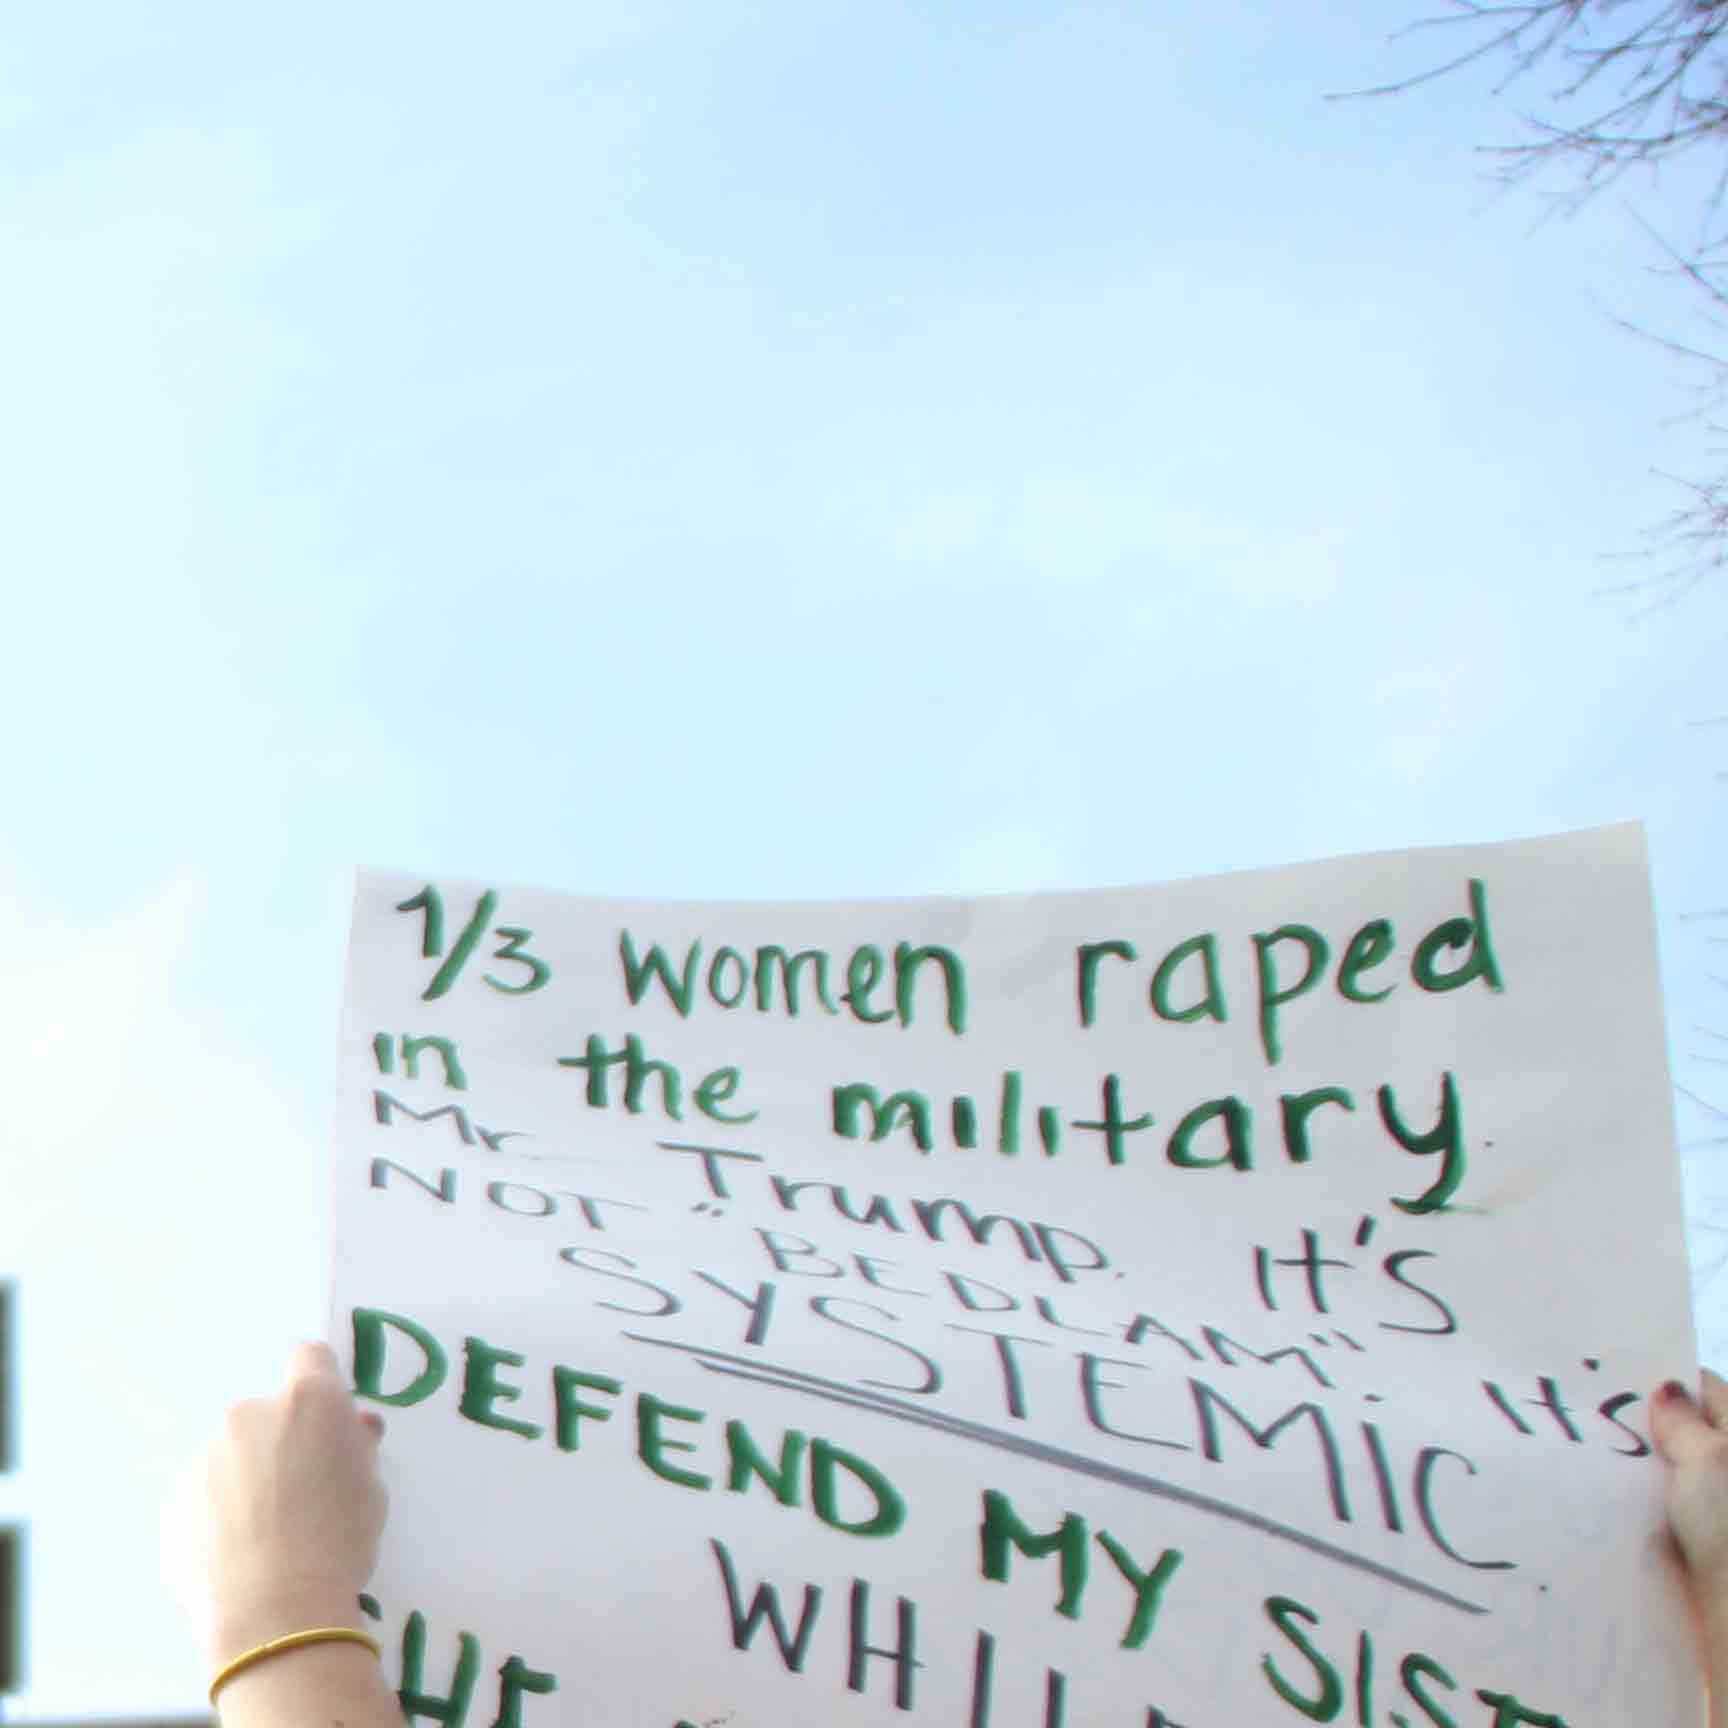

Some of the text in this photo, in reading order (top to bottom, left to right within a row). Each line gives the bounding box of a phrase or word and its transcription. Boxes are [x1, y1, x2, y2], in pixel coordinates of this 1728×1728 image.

[397, 876, 1508, 1066] 1/3 women raped
[373, 1030, 468, 1093] in
[556, 1031, 760, 1126] the
[370, 1158, 650, 1232] NOT
[349, 1306, 908, 1540] DEFEND
[978, 1488, 1185, 1650] MY
